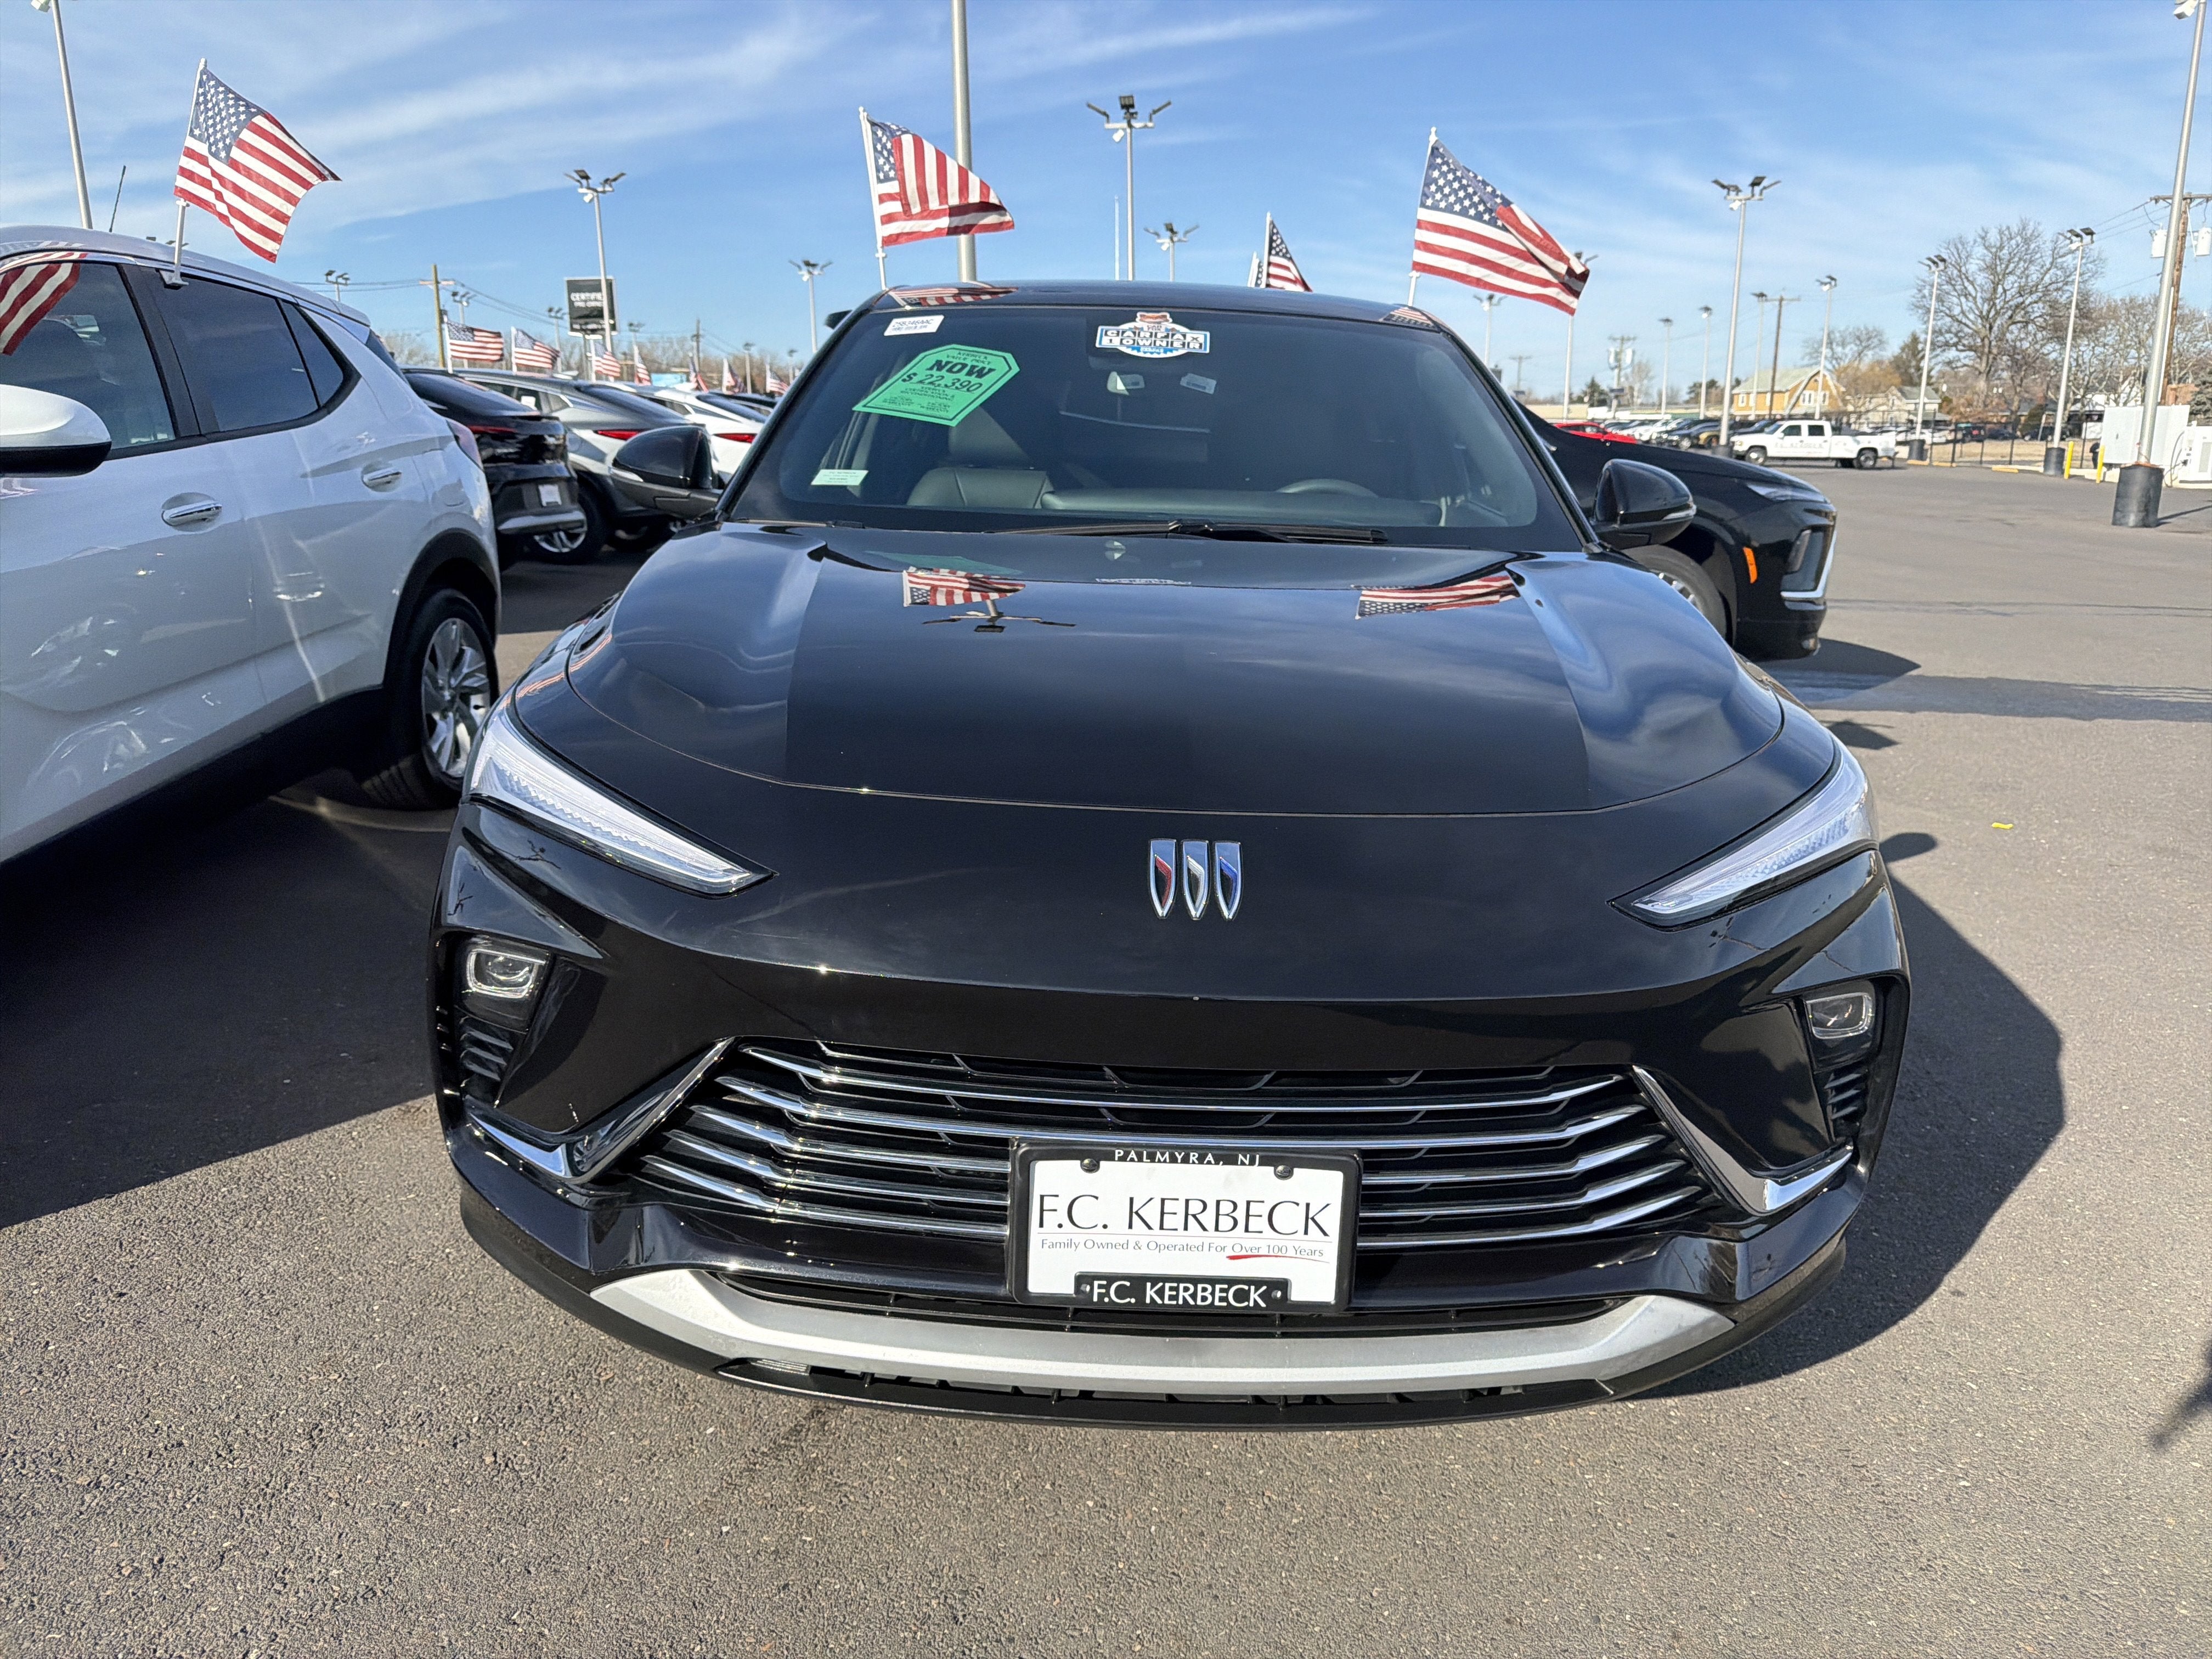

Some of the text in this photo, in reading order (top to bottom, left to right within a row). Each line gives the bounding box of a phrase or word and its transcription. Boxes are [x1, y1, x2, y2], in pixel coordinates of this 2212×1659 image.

[1107, 330, 1201, 343] CARFAX
[1122, 338, 1200, 349] OWNER
[926, 359, 996, 379] NOW
[1115, 1149, 1260, 1167] PALMYRA, NJ
[1039, 1194, 1332, 1237] F.C. KERBECK
[1041, 1238, 1324, 1257] Family Owned & Operated For Over 100 Years
[1093, 1280, 1267, 1307] F.C. KERBECK
